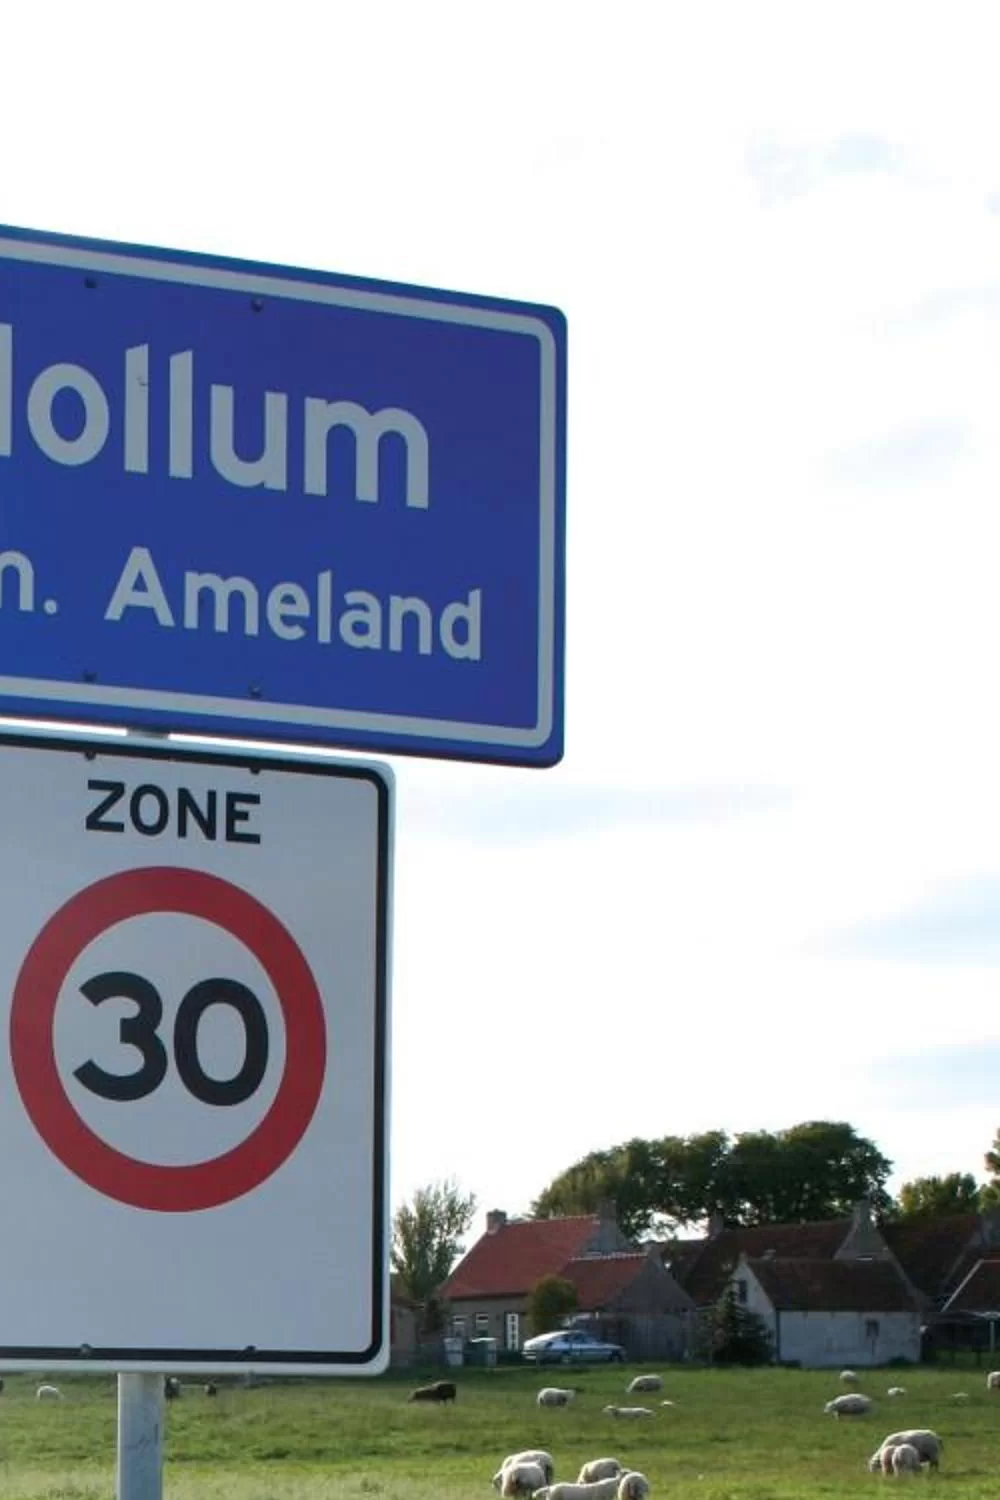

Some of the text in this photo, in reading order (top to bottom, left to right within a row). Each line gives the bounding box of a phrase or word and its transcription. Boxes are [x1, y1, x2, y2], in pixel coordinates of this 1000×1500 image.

[103, 546, 483, 661] Ameland
[85, 779, 262, 845] ZONE
[72, 970, 269, 1107] 30
